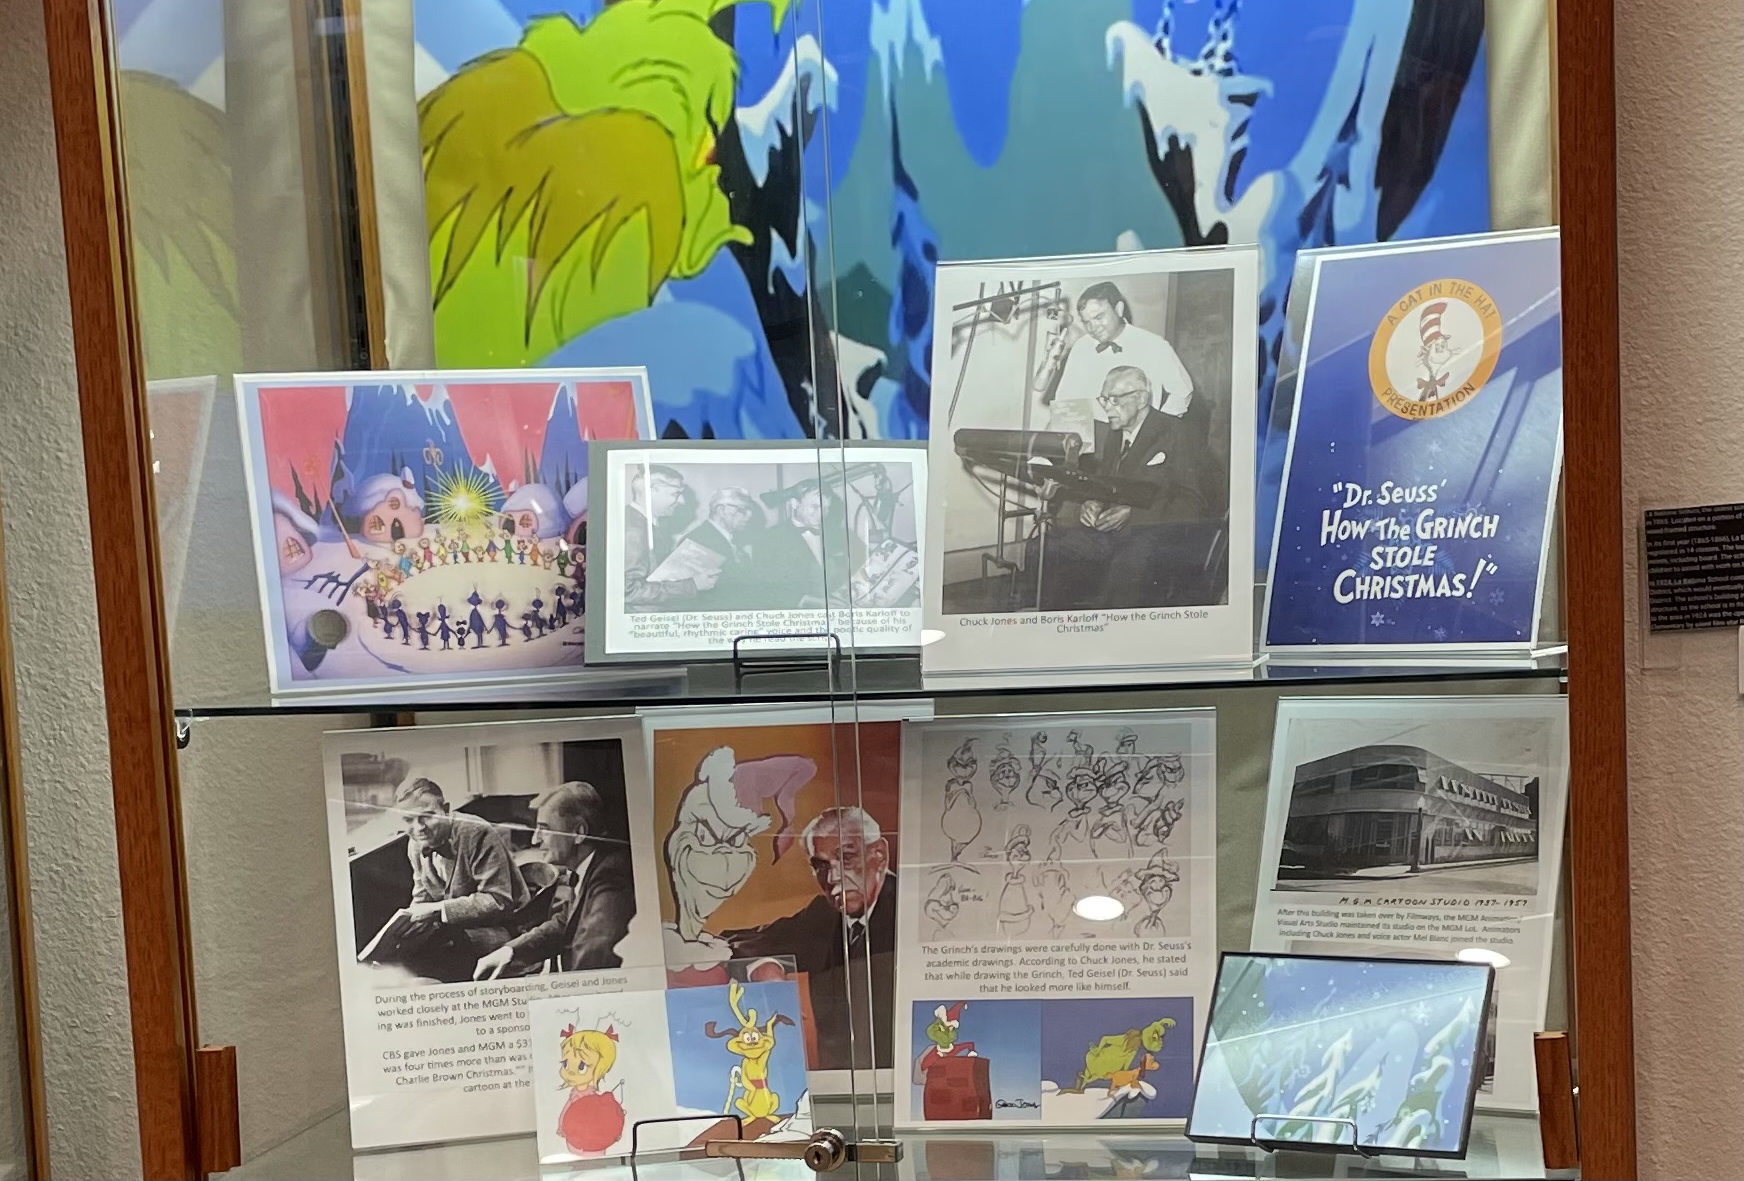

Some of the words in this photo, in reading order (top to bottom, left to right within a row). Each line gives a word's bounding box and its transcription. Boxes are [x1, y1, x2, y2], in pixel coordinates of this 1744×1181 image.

[1387, 314, 1398, 326] A
[1399, 290, 1424, 312] CAT
[1429, 283, 1443, 296] IN
[1450, 281, 1474, 299] THE
[1474, 294, 1497, 319] HAT
[1382, 382, 1476, 417] PRESENTATION
[1369, 545, 1438, 571] STOLE
[735, 612, 753, 620] and
[756, 611, 784, 620] Chuck
[788, 611, 815, 619] Jones
[960, 617, 988, 626] Chuck
[991, 617, 1017, 626] Jones
[1020, 616, 1037, 625] and
[1041, 615, 1064, 624] Boris
[1067, 613, 1098, 623] Karloff
[1131, 611, 1146, 621] the
[1149, 610, 1180, 621] Grinch
[1184, 609, 1208, 619] Stole
[702, 621, 718, 629] the
[721, 620, 753, 629] Grinch
[756, 620, 780, 628] Stole
[893, 617, 906, 625] his
[867, 625, 900, 633] quality
[902, 624, 912, 632] of
[1376, 898, 1427, 906] CARTOON
[1430, 898, 1470, 906] STUDIO
[1312, 930, 1334, 938] Chuck
[1335, 931, 1355, 939] Jones
[922, 945, 938, 954] The
[941, 945, 978, 954] Grinch's
[981, 944, 1022, 955] drawings
[1025, 945, 1048, 953] were
[1051, 942, 1090, 953] carefully
[1093, 942, 1116, 952] done
[1120, 942, 1140, 951] with
[1158, 941, 1192, 951] Seuss's
[926, 959, 969, 968] academic
[1019, 956, 1065, 967] According
[1068, 956, 1077, 965] to
[1080, 955, 1109, 965] Chuck
[1111, 955, 1140, 966] Jones,
[1142, 954, 1154, 964] he
[1157, 954, 1187, 964] stated
[924, 972, 943, 981] that
[946, 971, 971, 980] while
[974, 970, 1010, 981] drawing
[1013, 970, 1028, 979] the
[1068, 969, 1083, 978] Ted
[1086, 968, 1115, 978] Geisel
[1137, 967, 1167, 979] Seuss)
[1169, 967, 1189, 977] said
[375, 994, 407, 1005] During
[410, 993, 426, 1002] the
[429, 990, 465, 1001] process
[468, 987, 477, 997] of
[551, 979, 580, 990] Geisel
[582, 978, 599, 987] and
[602, 976, 628, 986] Jones
[979, 984, 998, 993] that
[1001, 983, 1012, 992] he
[1015, 982, 1046, 992] looked
[1049, 983, 1073, 991] more
[1076, 982, 1092, 991] like
[1094, 981, 1131, 991] himself.
[378, 1005, 414, 1017] worked
[417, 1003, 449, 1015] closely
[451, 1002, 461, 1011] at
[463, 1001, 480, 1010] the
[482, 998, 509, 1009] MGM
[378, 1022, 392, 1032] ing
[395, 1020, 414, 1029] was
[416, 1015, 457, 1027] finished,
[460, 1014, 487, 1024] Jones
[489, 1012, 512, 1021] went
[515, 1010, 526, 1019] to
[476, 1026, 487, 1036] to
[382, 1050, 402, 1060] CBS
[404, 1049, 426, 1060] gave
[428, 1045, 455, 1056] Jones
[458, 1044, 476, 1053] and
[478, 1040, 505, 1051] MGM
[383, 1065, 402, 1074] was
[405, 1062, 425, 1071] four
[428, 1060, 454, 1069] times
[457, 1057, 482, 1067] more
[484, 1055, 506, 1064] than
[509, 1054, 527, 1062] was
[396, 1075, 430, 1086] Charlie
[433, 1072, 463, 1082] Brown
[463, 1082, 500, 1093] cartoon
[503, 1080, 512, 1089] at
[515, 1079, 531, 1088] the
